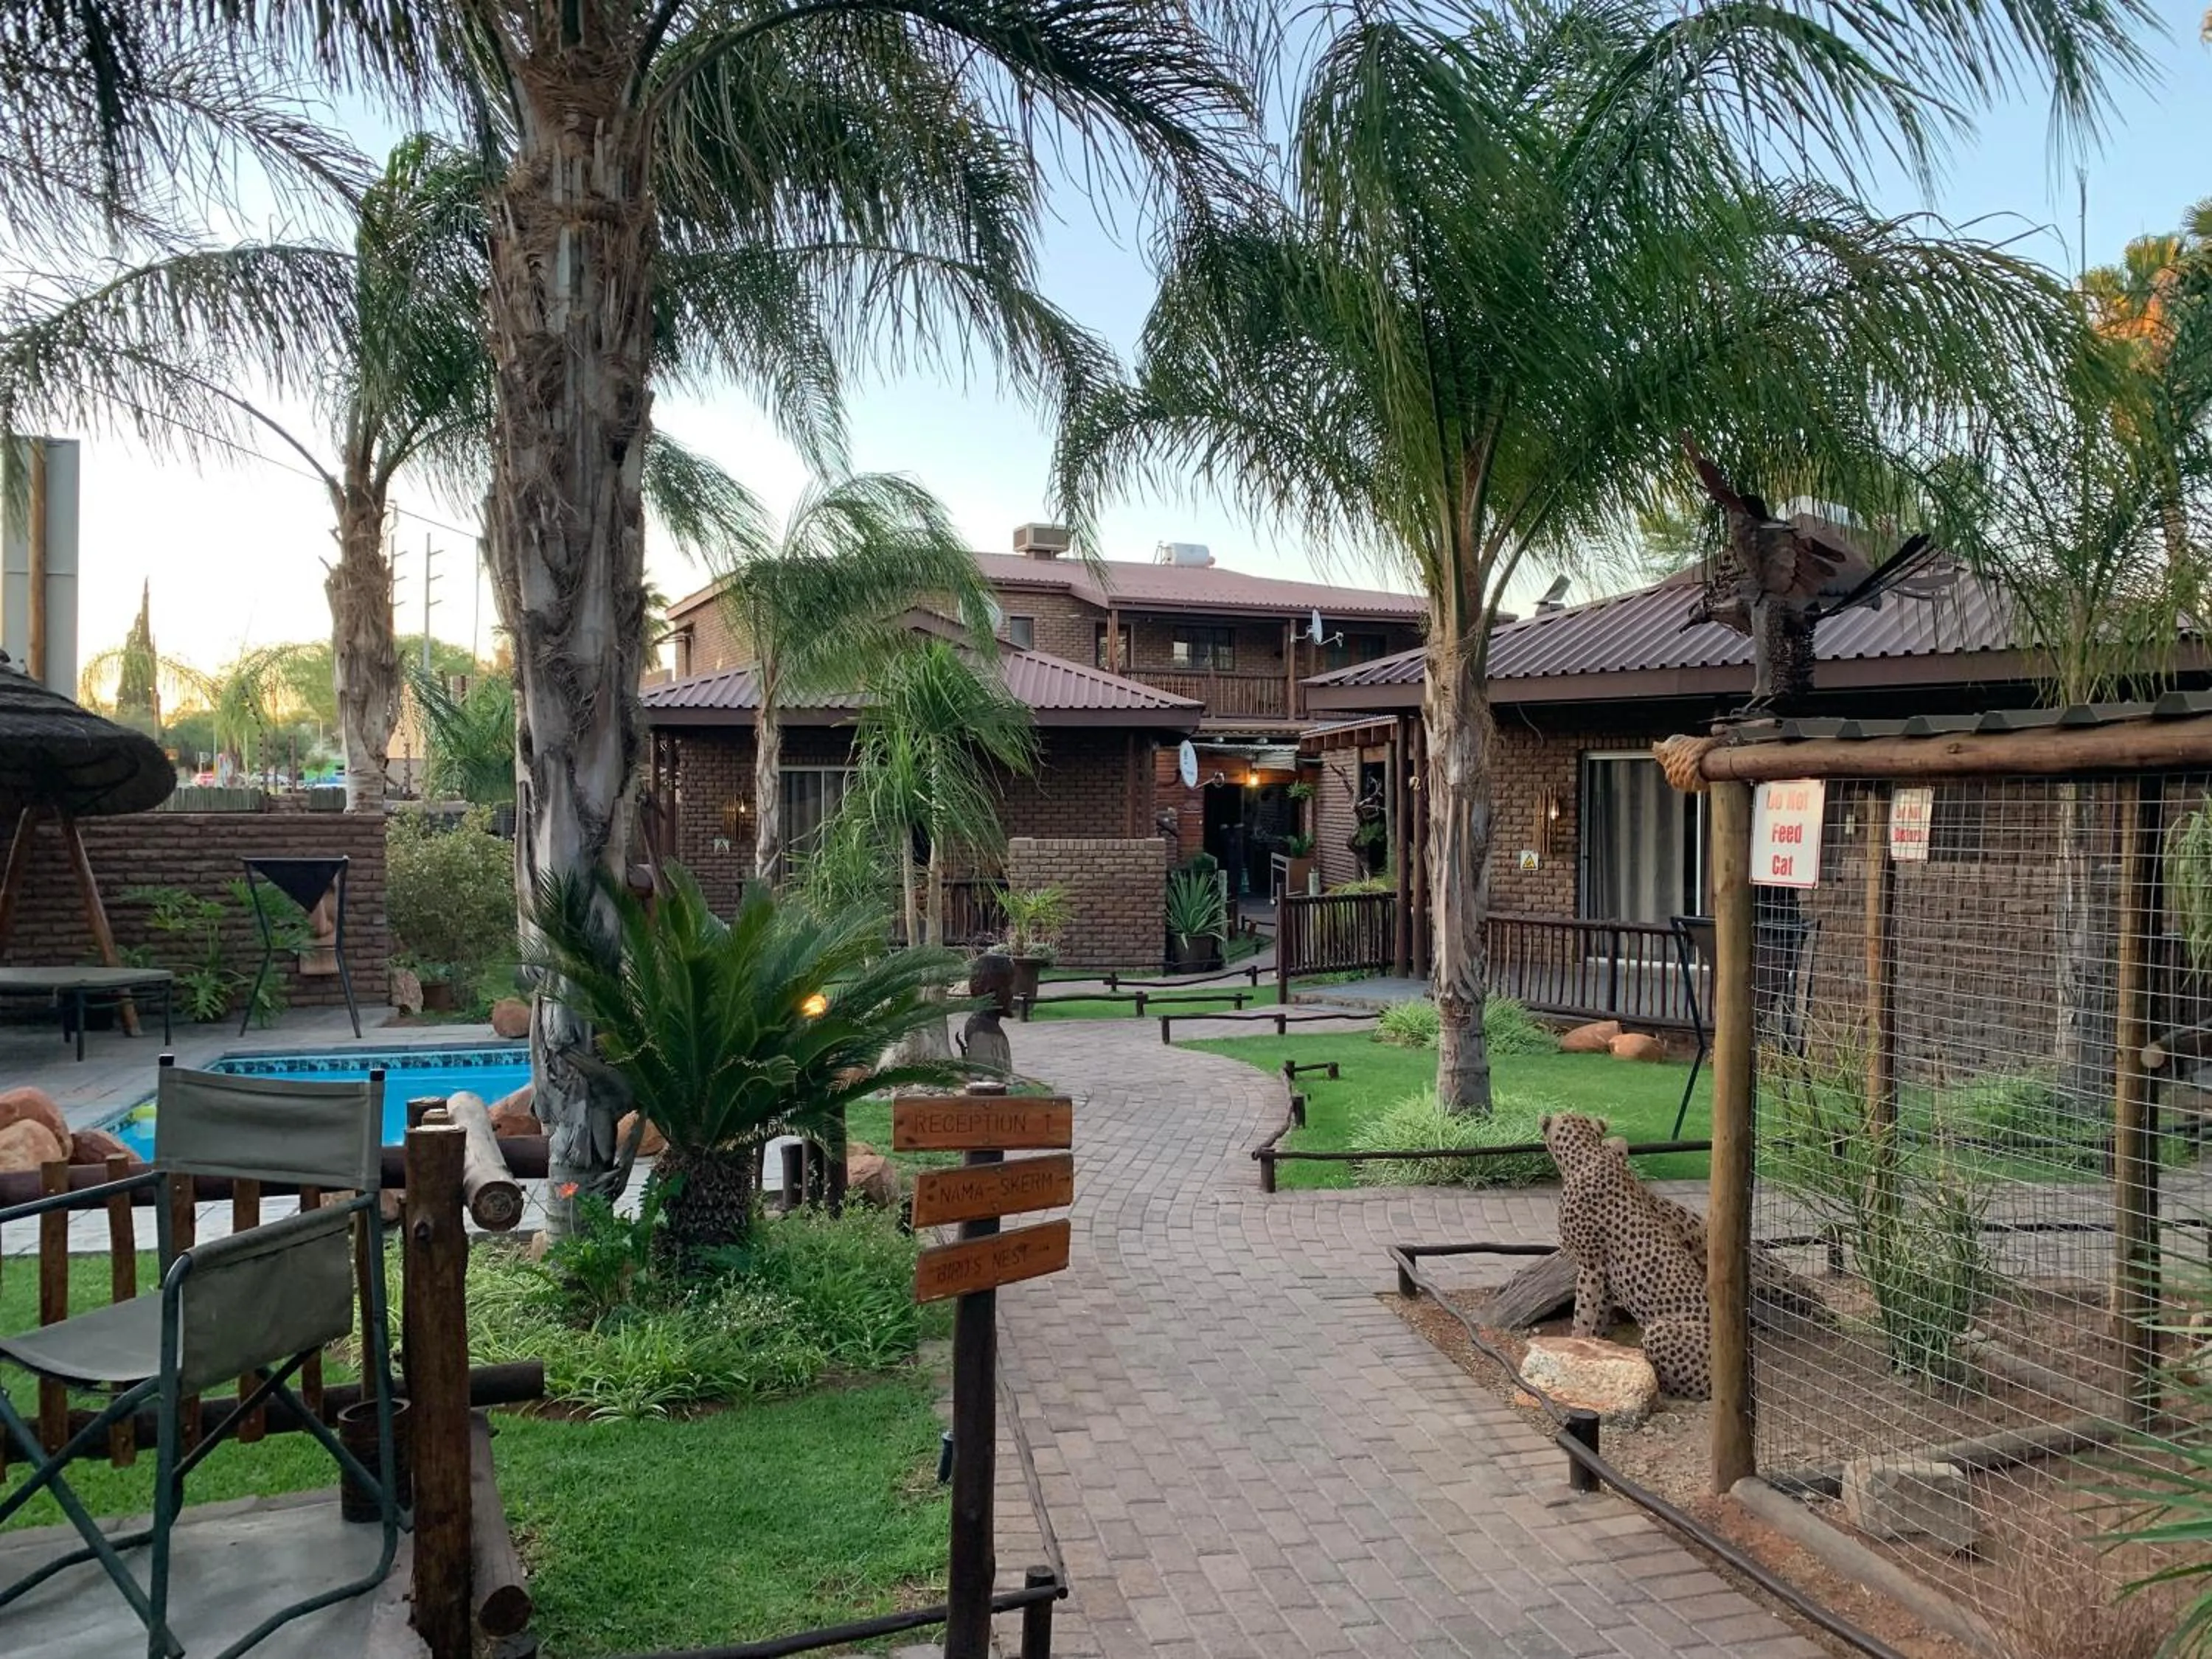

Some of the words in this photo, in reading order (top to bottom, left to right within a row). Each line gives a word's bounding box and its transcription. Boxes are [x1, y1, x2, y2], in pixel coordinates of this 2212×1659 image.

[1766, 790, 1783, 810] Do
[1787, 790, 1809, 810] Not
[1772, 822, 1803, 844] Feed
[1772, 855, 1793, 876] Cat
[914, 1112, 1027, 1133] RECEPTION
[992, 1242, 1031, 1270] NEST
